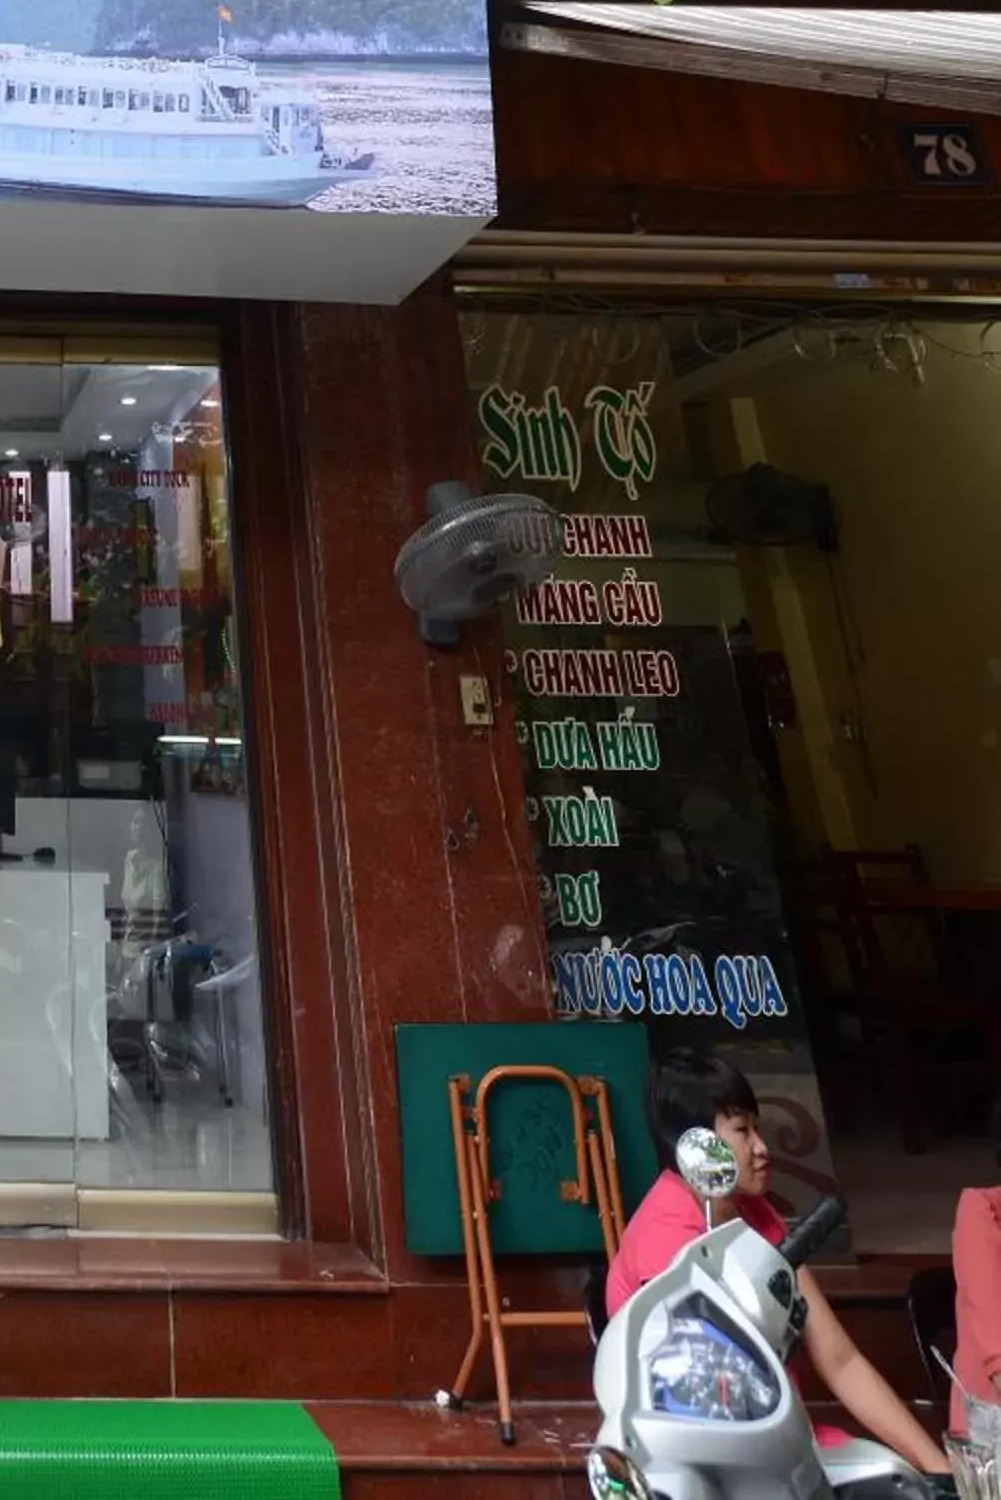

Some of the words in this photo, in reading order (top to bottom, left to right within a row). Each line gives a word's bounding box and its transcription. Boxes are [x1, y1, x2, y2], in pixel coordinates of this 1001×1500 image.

[913, 133, 977, 176] 78
[479, 384, 582, 492] Sinh
[562, 514, 653, 559] CHANH
[523, 649, 623, 697] CHANH
[623, 649, 680, 697] LEO
[532, 717, 599, 770] DƯA
[543, 785, 619, 847] XOÀI
[555, 871, 602, 927] BƠ
[644, 953, 718, 1016] HOA
